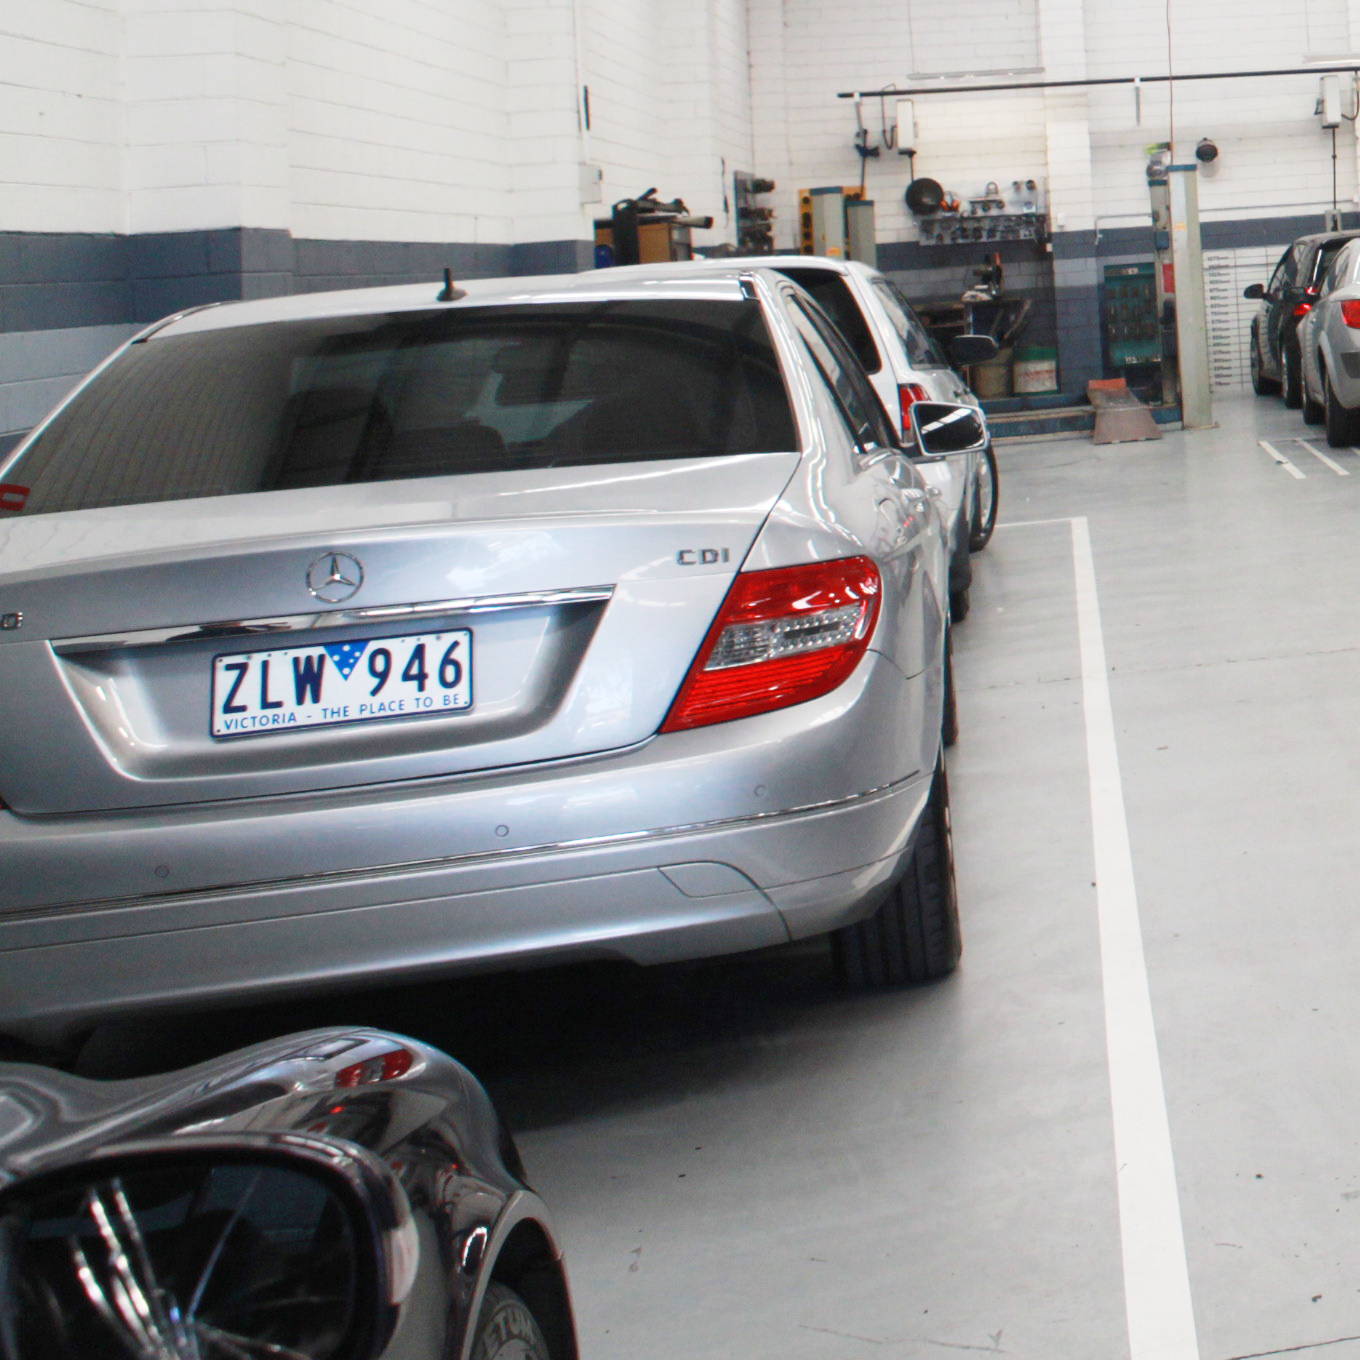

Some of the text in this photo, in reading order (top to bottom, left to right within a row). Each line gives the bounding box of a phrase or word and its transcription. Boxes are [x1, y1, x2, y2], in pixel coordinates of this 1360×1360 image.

[677, 548, 730, 566] CDI
[222, 640, 463, 715] ZLW 946
[224, 712, 297, 731] VICTORIA
[321, 705, 350, 719] THE
[359, 700, 405, 715] PLACE
[414, 696, 433, 709] TO
[443, 694, 460, 706] BE
